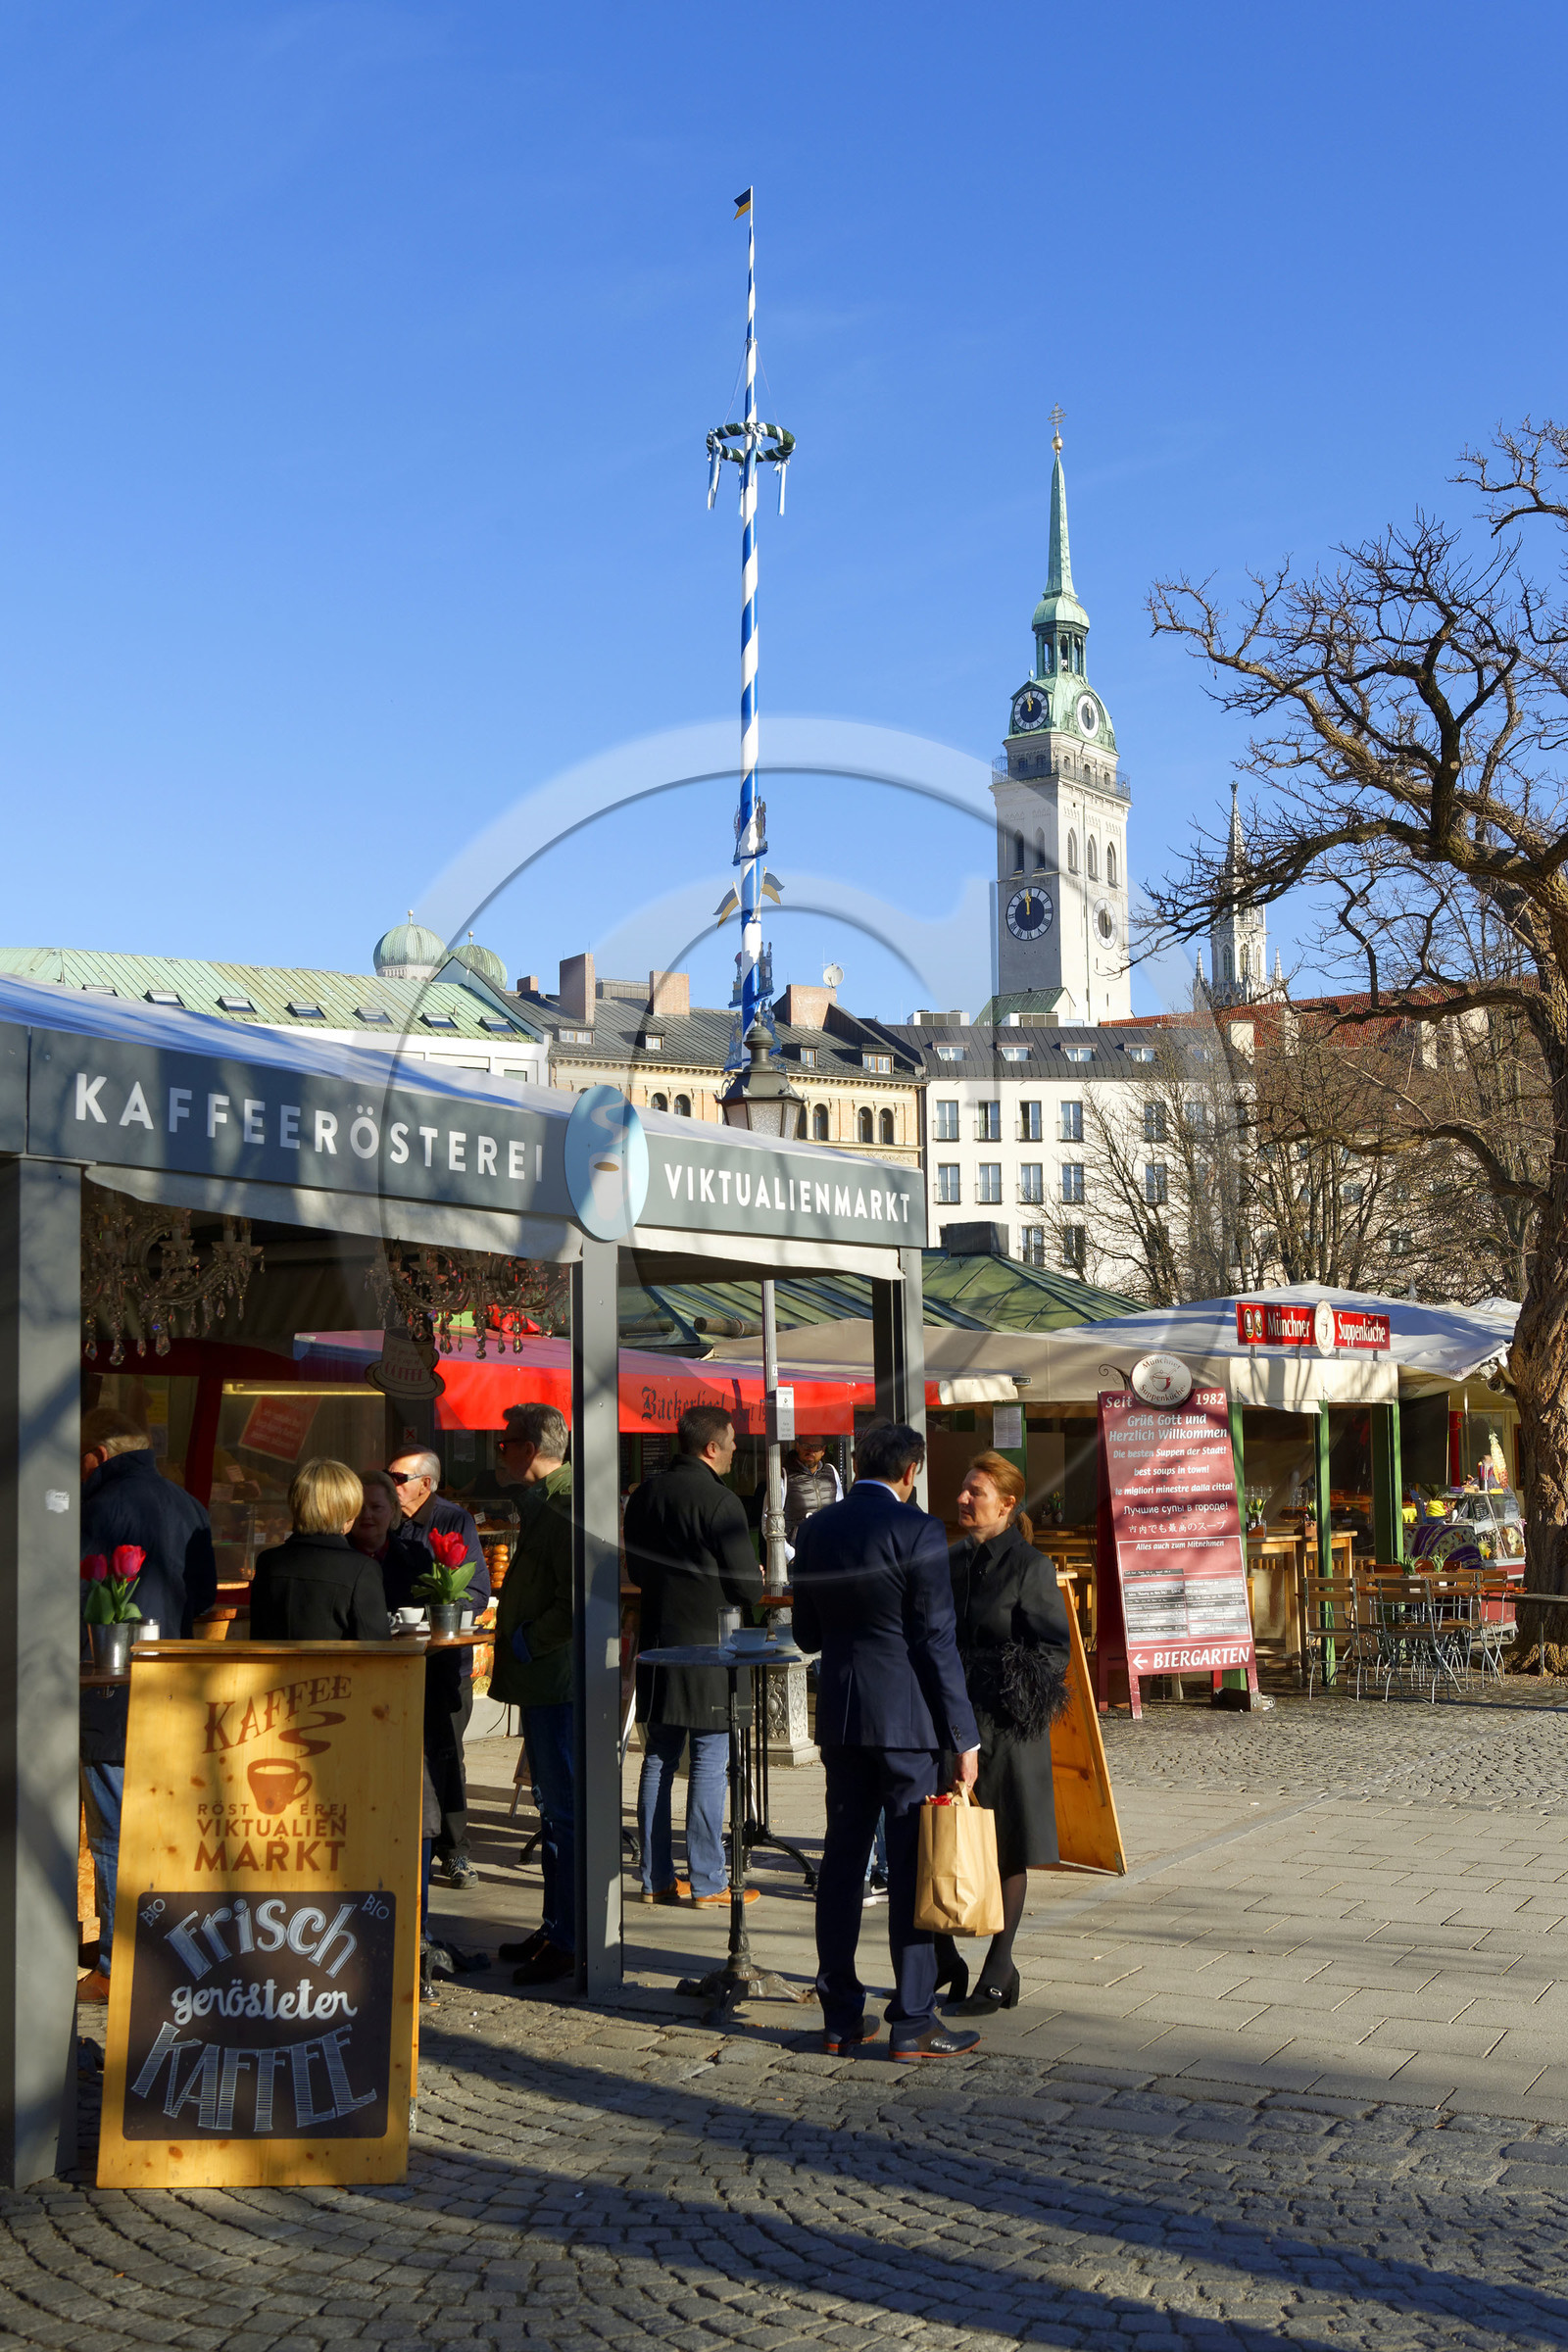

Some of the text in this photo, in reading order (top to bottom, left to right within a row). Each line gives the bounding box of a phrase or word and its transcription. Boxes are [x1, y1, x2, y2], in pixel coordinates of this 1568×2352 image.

[74, 1072, 543, 1183] KAFFEERÖSTEREI
[663, 1163, 910, 1224] VIKTUALIENMARKT
[1267, 1311, 1310, 1338] Münchner
[1338, 1313, 1386, 1347] Suppenküche
[1105, 1393, 1224, 1408] Seit 1982
[1127, 1413, 1207, 1427] Grüß Gott und
[1108, 1428, 1227, 1442] Herzlich Willkommen
[1113, 1450, 1126, 1459] Die
[1127, 1449, 1154, 1458] besten
[1156, 1448, 1185, 1457] Suppen
[1201, 1446, 1227, 1455] Stadt!
[1134, 1467, 1152, 1476] best
[1152, 1467, 1175, 1476] soups
[1124, 1486, 1153, 1495] migliori
[1155, 1486, 1189, 1494] minestre
[1191, 1484, 1210, 1493] dalla
[1123, 1505, 1159, 1516] Лучшие
[1161, 1505, 1185, 1514] супы
[1195, 1501, 1229, 1513] городе!
[1129, 1520, 1227, 1535] 市内でも最高のスープ
[1136, 1543, 1152, 1551] Alles
[1187, 1540, 1225, 1548] Mitnehmen
[1152, 1646, 1250, 1669] BIERGARTEN
[202, 1674, 352, 1754] KAFFEE
[198, 1799, 347, 1815] RÖST EREI
[197, 1819, 346, 1838] VIKTUALIEN
[194, 1840, 346, 1872] MARKT
[140, 1898, 167, 1927] BIO
[362, 1893, 390, 1920] BIO
[164, 1898, 358, 1981] Frisch
[170, 1979, 359, 2026] gerösteter
[130, 2021, 378, 2132] KAFFEE
